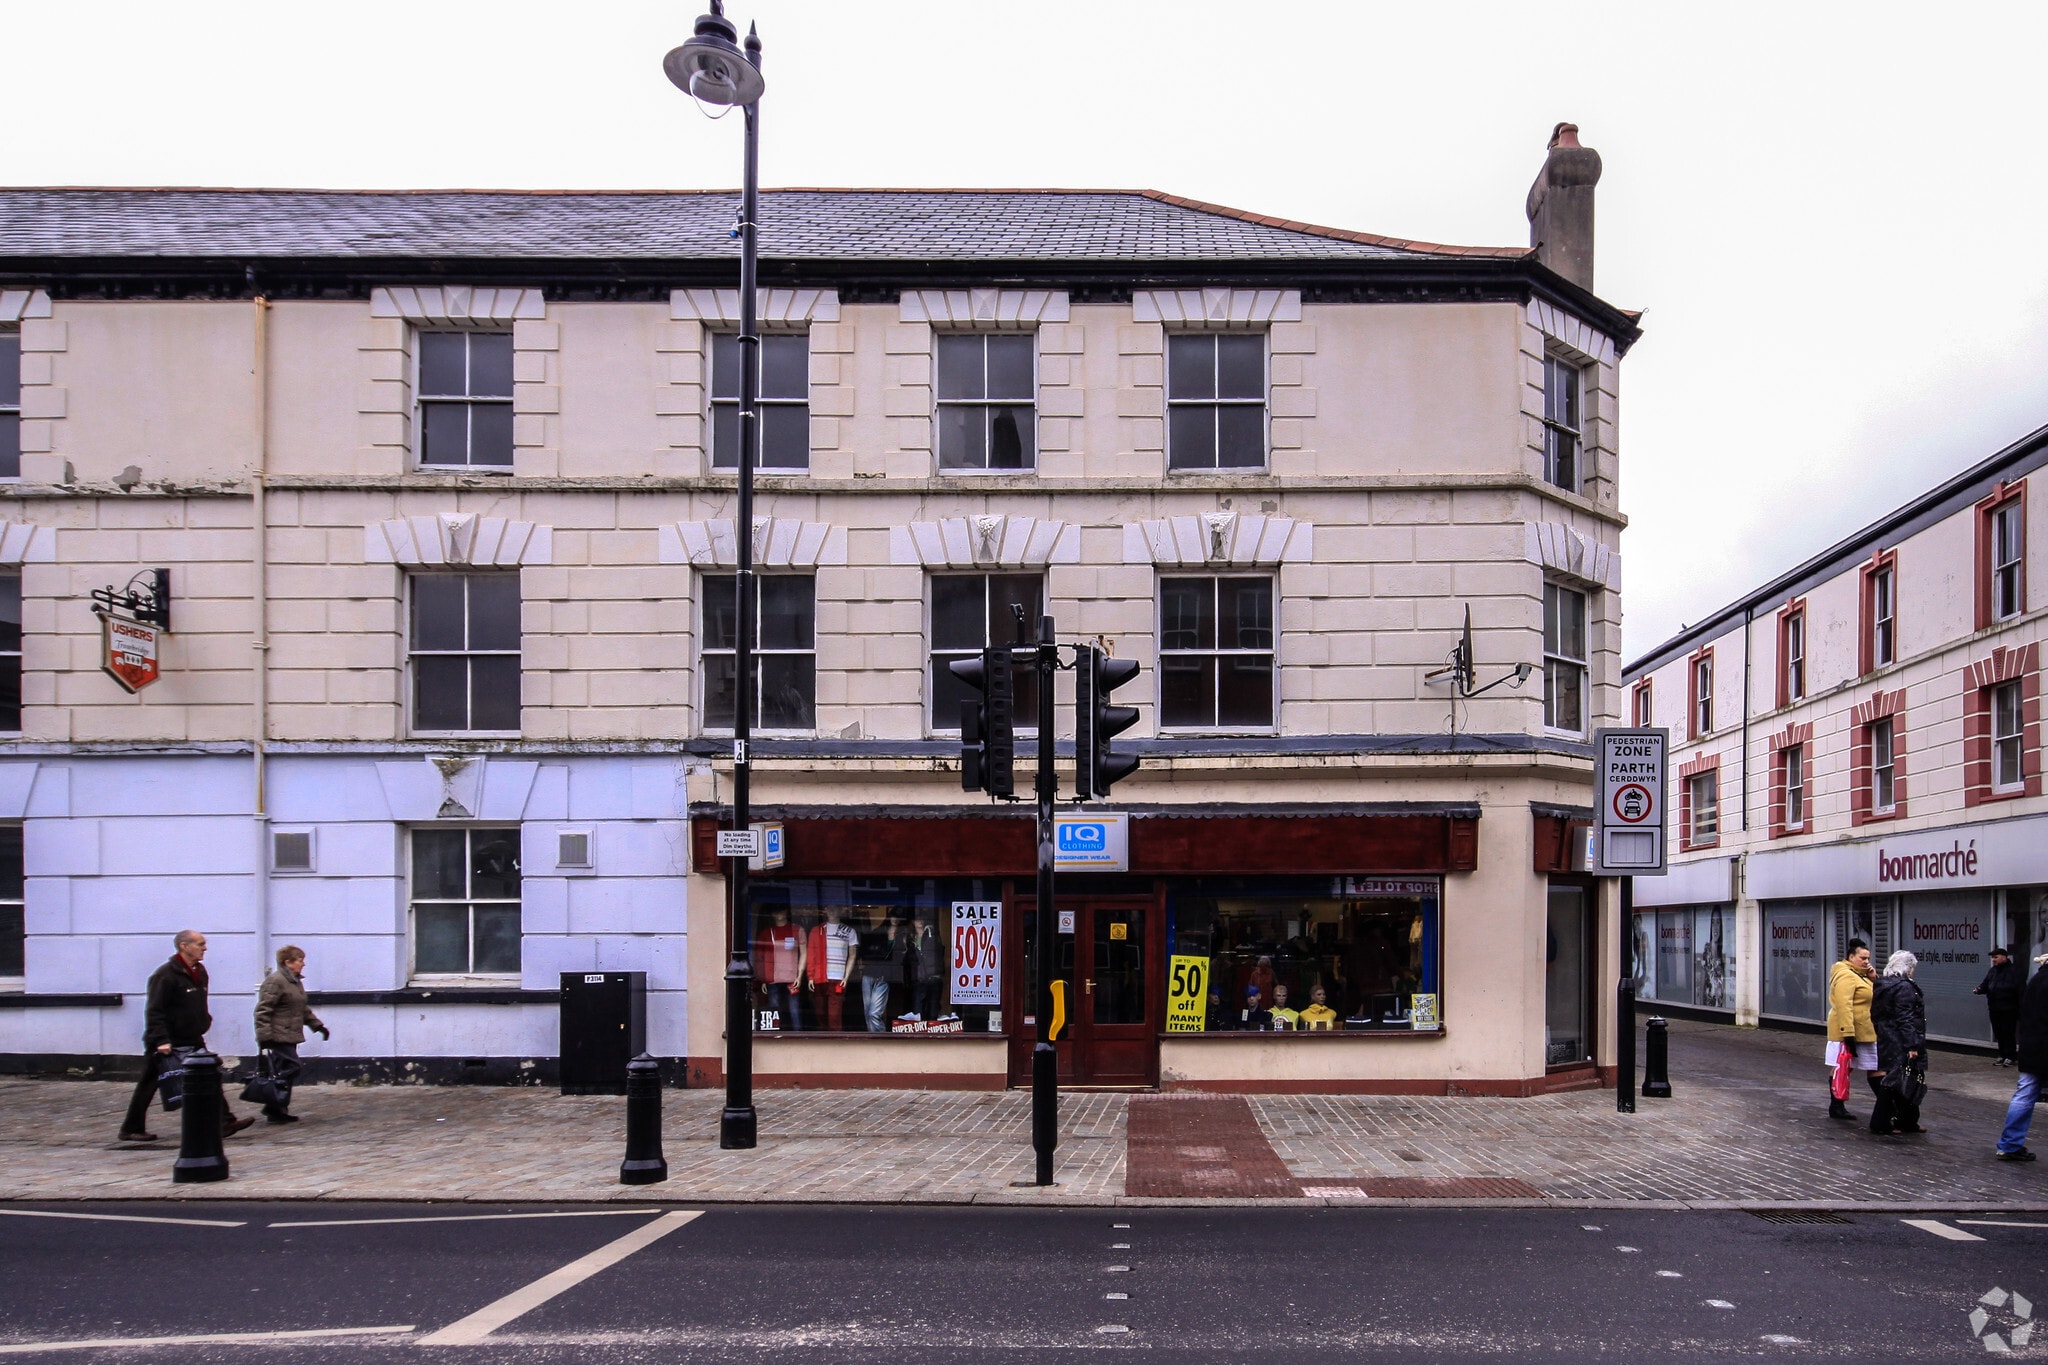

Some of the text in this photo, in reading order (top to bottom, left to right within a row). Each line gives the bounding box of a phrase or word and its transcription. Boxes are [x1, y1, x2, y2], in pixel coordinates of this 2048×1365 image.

[112, 623, 153, 642] USHERS
[1614, 746, 1652, 757] ZONE
[1611, 763, 1655, 773] PARTH
[1609, 775, 1657, 783] CERDDWYR
[769, 832, 778, 844] IQ
[1065, 826, 1100, 842] IQ
[1879, 839, 1978, 882] bonmarché
[956, 906, 998, 919] SALE
[1772, 920, 1815, 940] bonmarché
[1914, 917, 1980, 941] bonmarché
[955, 925, 997, 969] 50%
[1942, 948, 1954, 963] real
[1954, 952, 1980, 964] women
[958, 974, 994, 987] OFF
[1178, 1000, 1195, 1010] off
